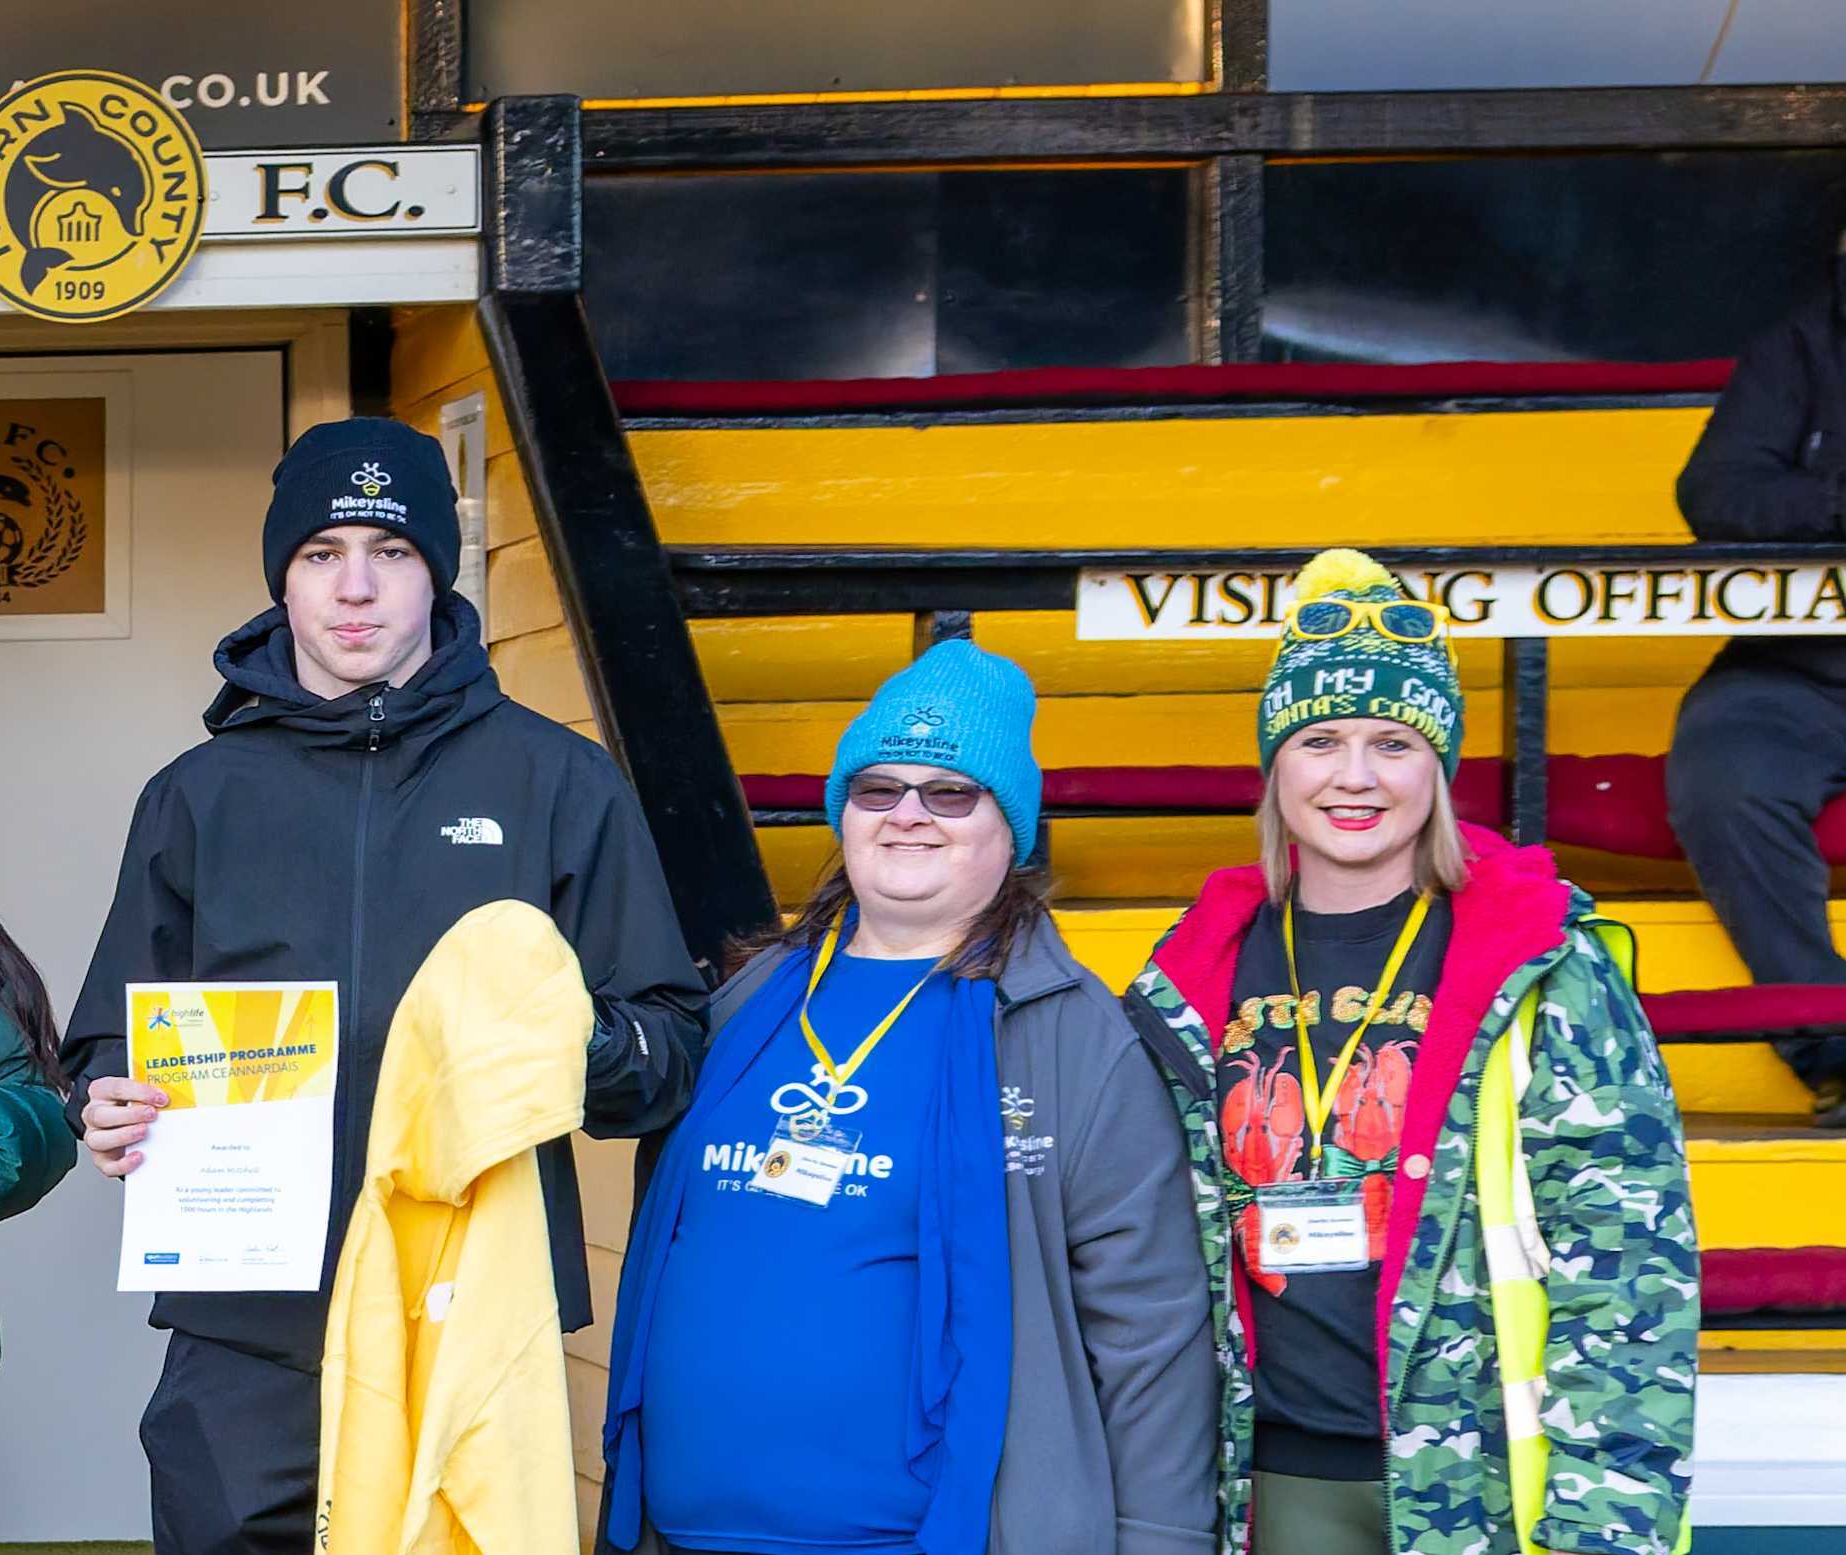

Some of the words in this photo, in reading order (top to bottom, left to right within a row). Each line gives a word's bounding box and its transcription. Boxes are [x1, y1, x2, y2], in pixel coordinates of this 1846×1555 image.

[100, 94, 189, 264] COUNTY
[252, 159, 426, 225] F.C.
[56, 280, 106, 300] 1909
[332, 495, 407, 515] Mikeysline
[1124, 570, 1496, 629] VISING
[1313, 667, 1375, 697] MY
[146, 1052, 227, 1070] LEADERSHIP
[229, 1043, 317, 1061] PROGRAMME
[147, 1069, 210, 1085] PROGRAM
[211, 1061, 299, 1079] CEANNARDAIS
[702, 1142, 894, 1178] Mikne
[716, 1179, 742, 1192] IT'S
[845, 1183, 869, 1197] OK
